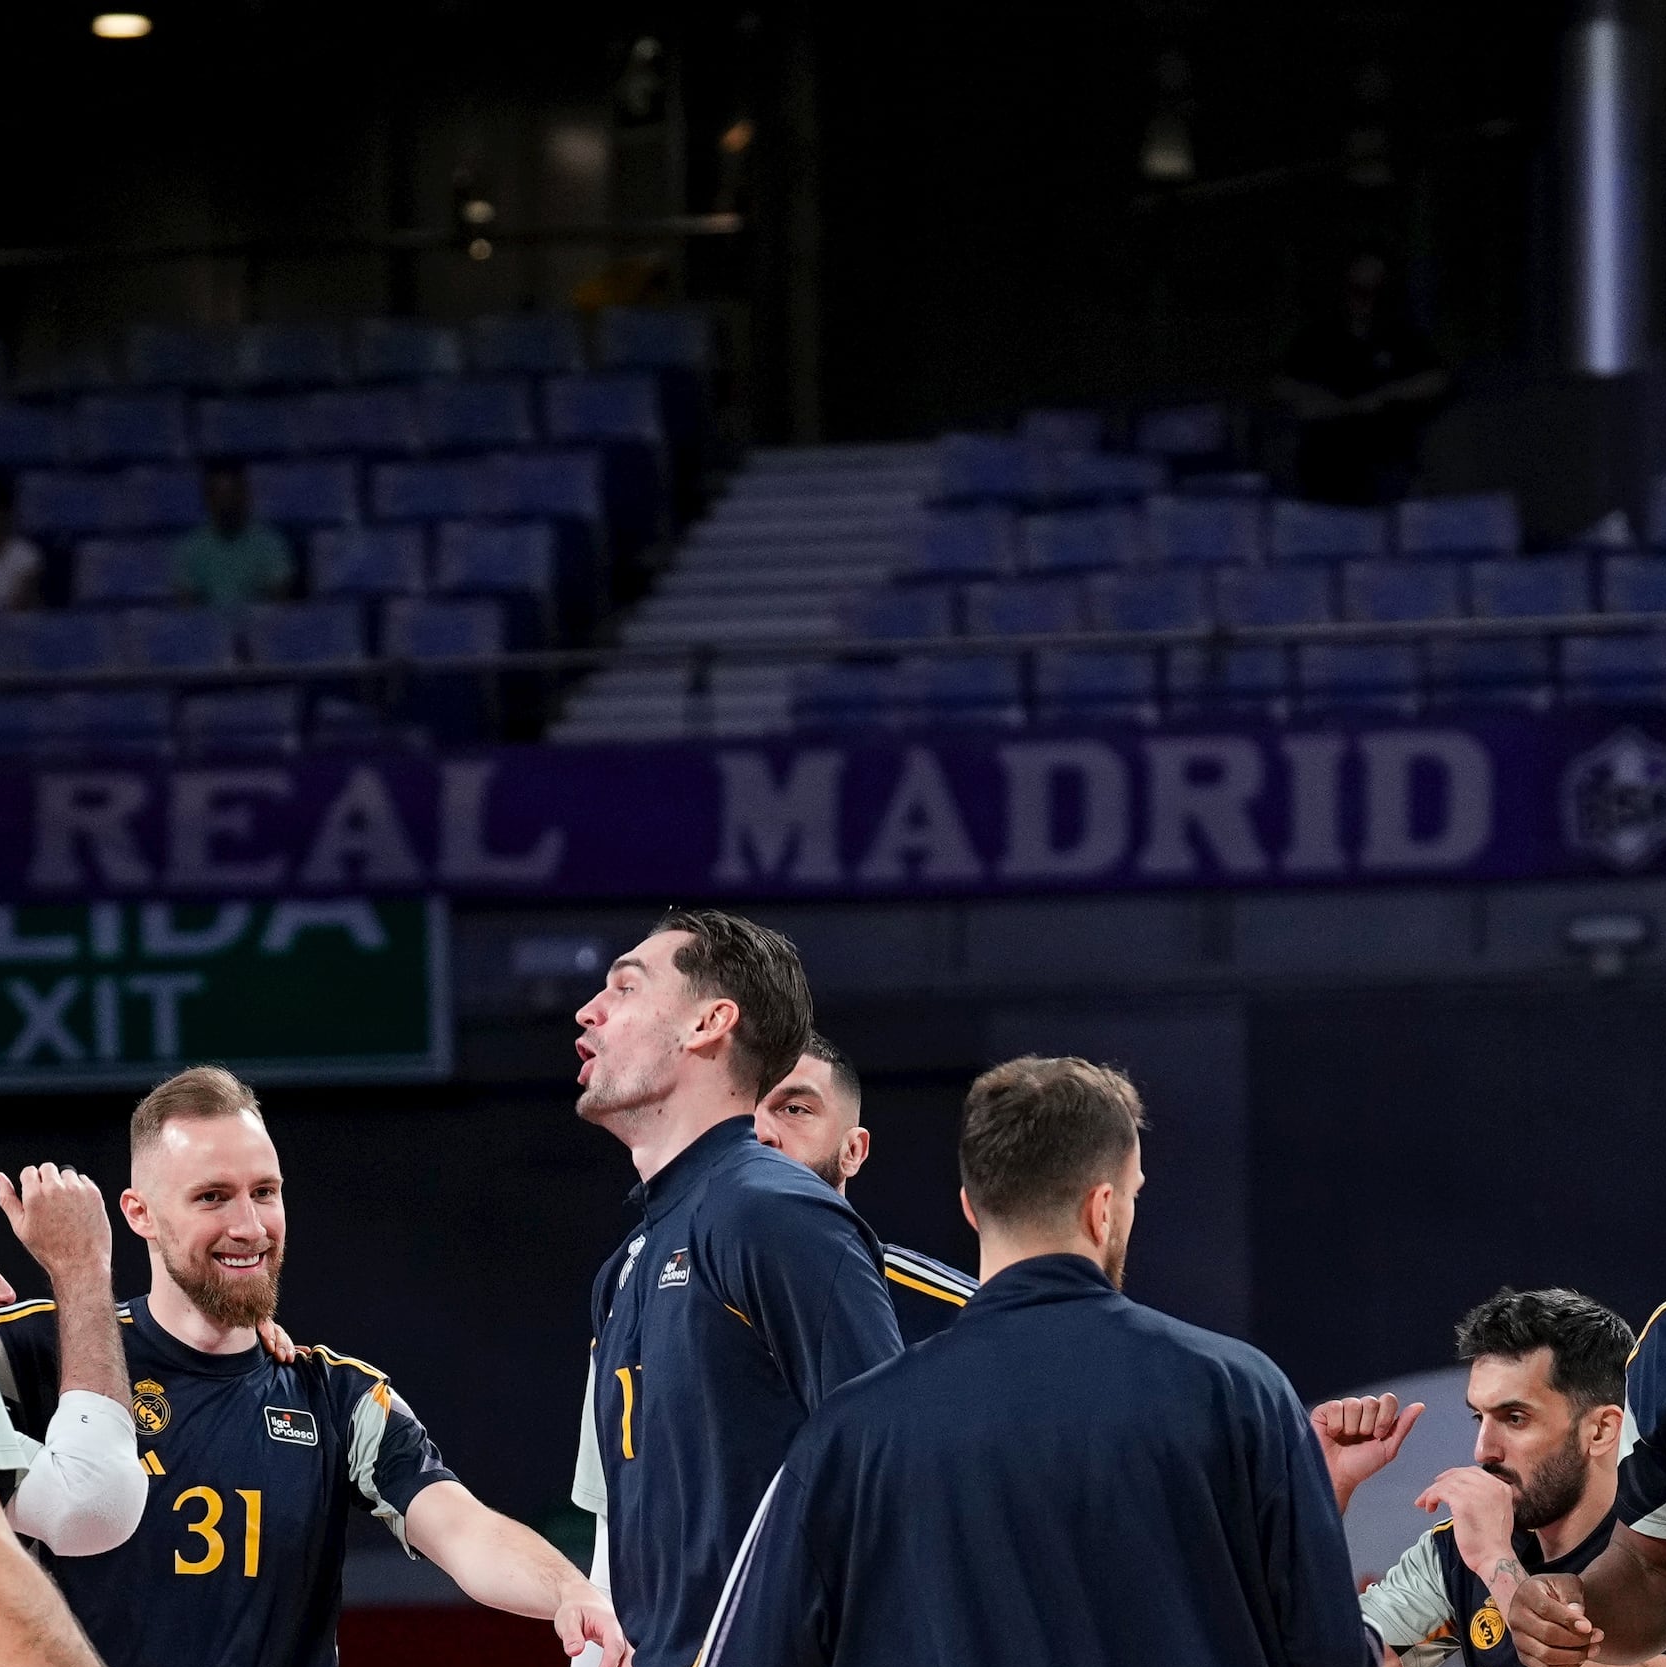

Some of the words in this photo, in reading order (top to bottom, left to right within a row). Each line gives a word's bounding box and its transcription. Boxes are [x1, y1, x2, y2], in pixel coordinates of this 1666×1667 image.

[27, 757, 567, 892] REAL
[711, 728, 1494, 884] MADRID
[271, 1415, 291, 1429] liga
[273, 1425, 314, 1441] endesa
[172, 1485, 263, 1578] 31
